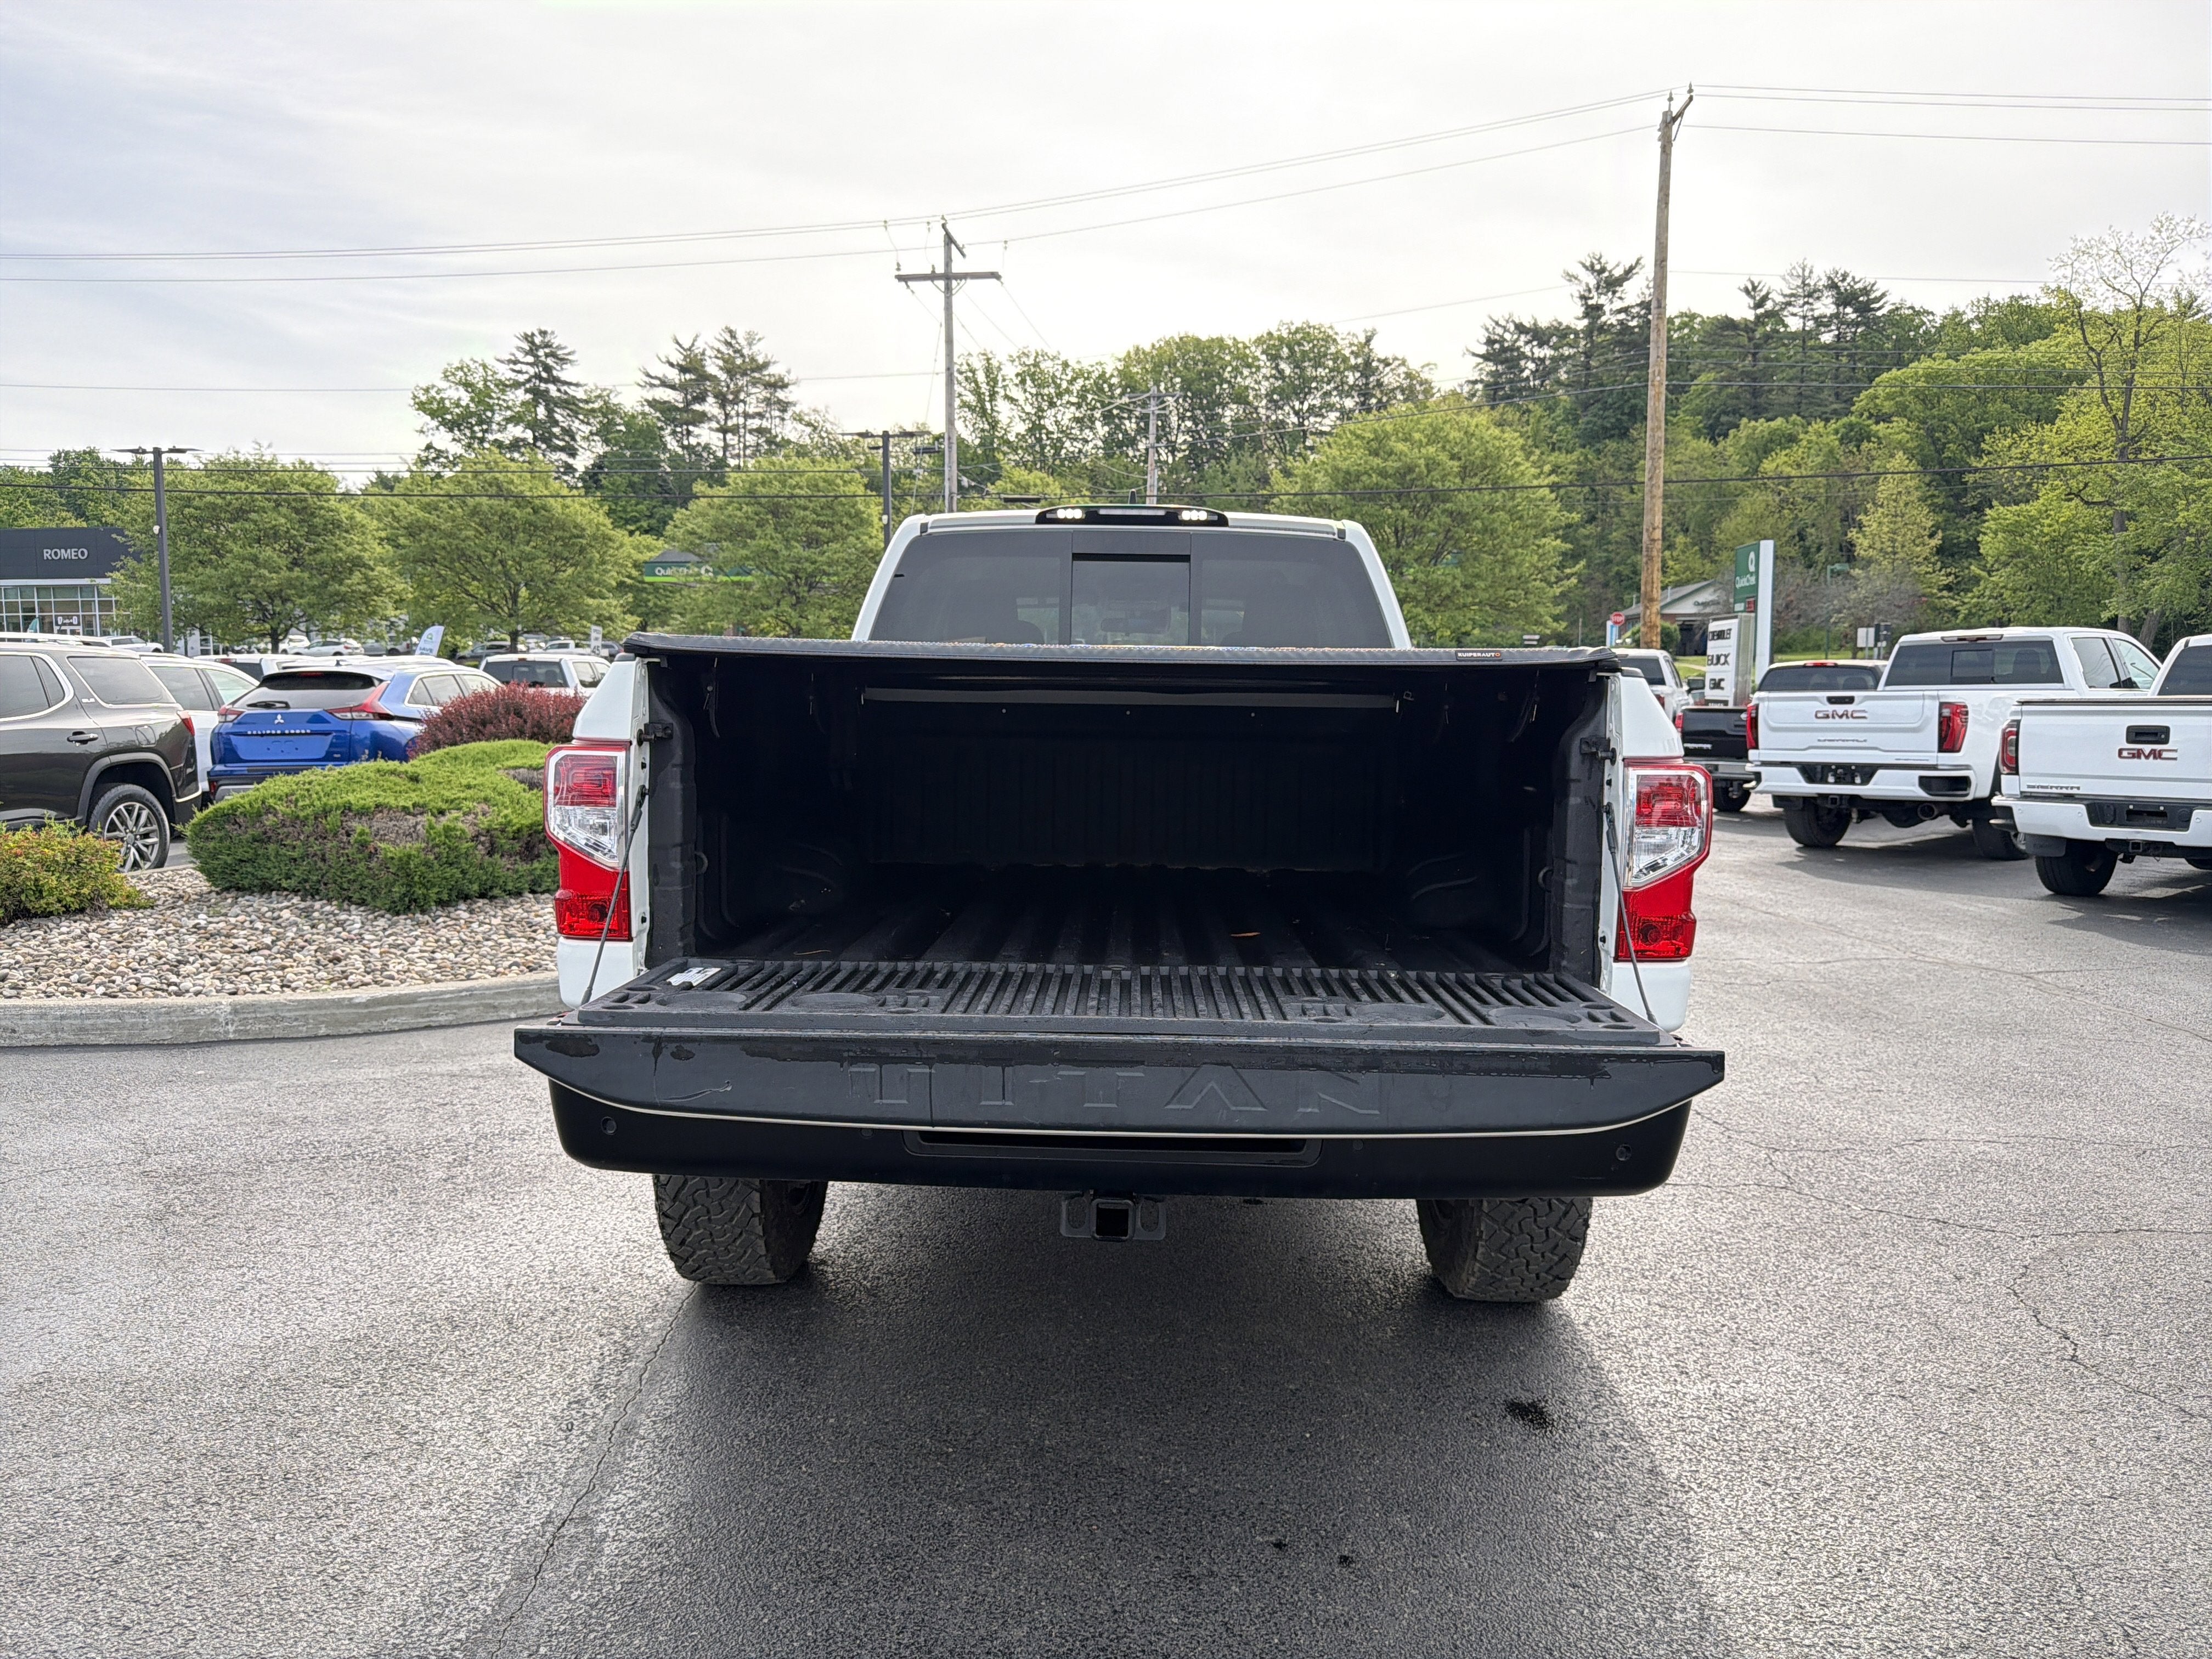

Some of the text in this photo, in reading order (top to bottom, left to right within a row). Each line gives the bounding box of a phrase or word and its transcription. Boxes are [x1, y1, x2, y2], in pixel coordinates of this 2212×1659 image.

[43, 548, 88, 560] ROMEO
[592, 645, 601, 656] 45
[1707, 652, 1730, 666] BUICK
[1814, 709, 1867, 720] GMC
[2118, 747, 2178, 761] GMC
[848, 1056, 1382, 1115] TITAN
